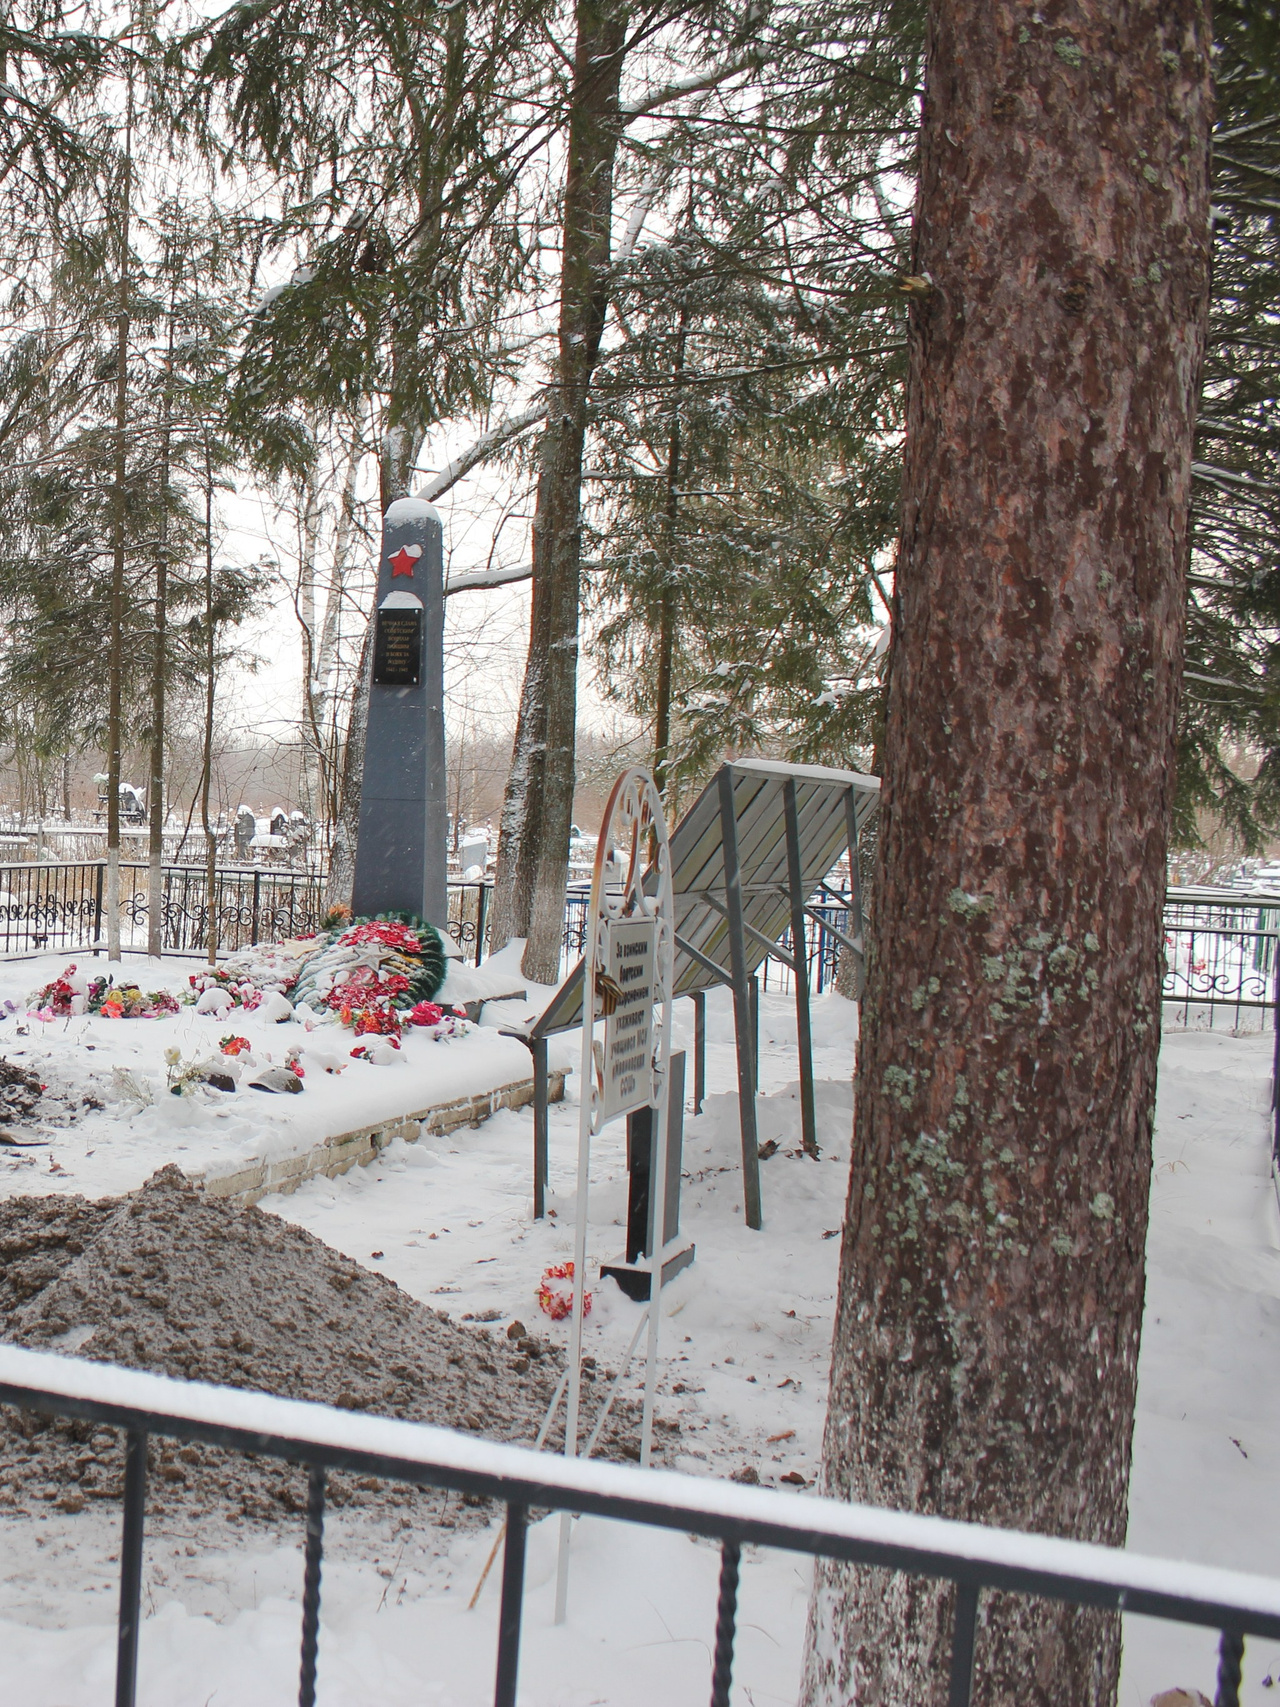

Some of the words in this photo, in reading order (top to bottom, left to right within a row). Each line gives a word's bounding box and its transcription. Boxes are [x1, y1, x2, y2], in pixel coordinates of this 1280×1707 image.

[616, 941, 623, 959] За
[624, 941, 648, 958] воинским
[619, 964, 644, 985] братским
[615, 1009, 645, 1035] ухаживают
[610, 1035, 636, 1061] учащиеся
